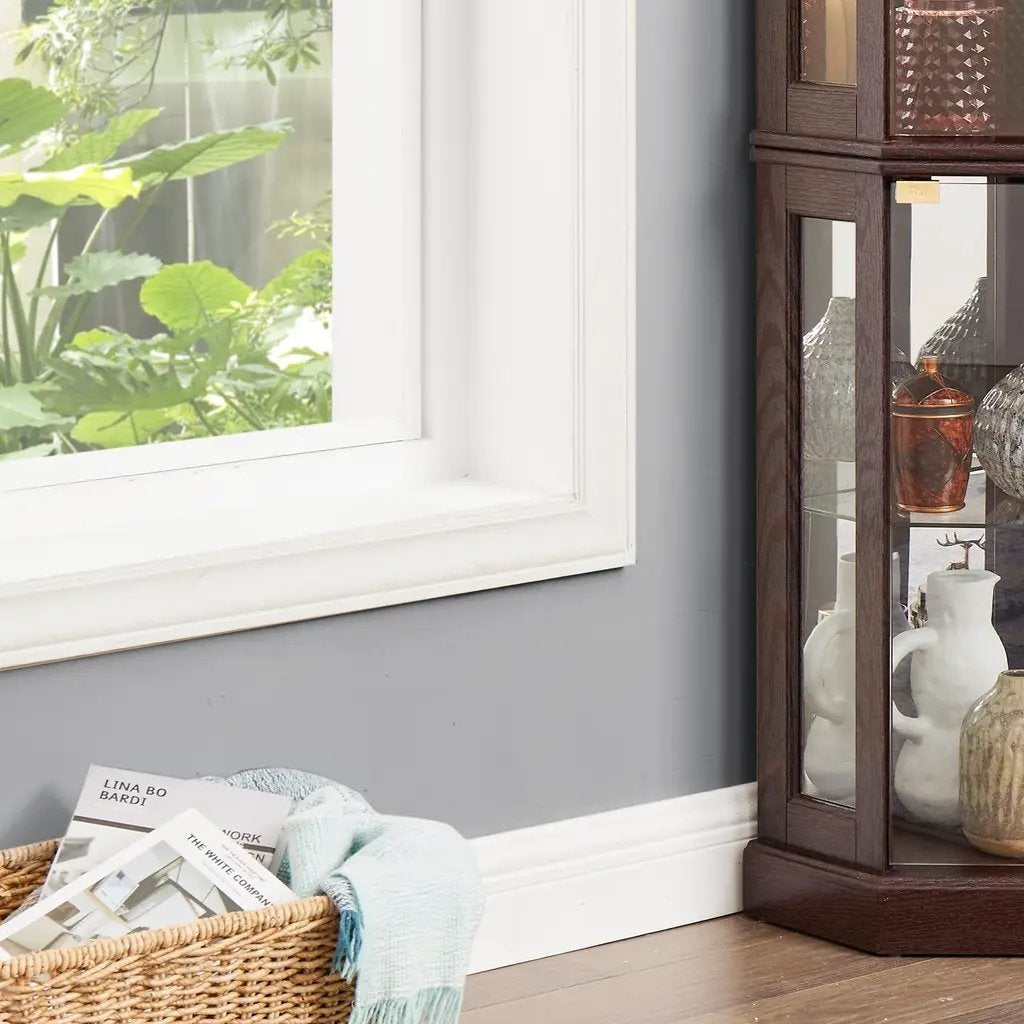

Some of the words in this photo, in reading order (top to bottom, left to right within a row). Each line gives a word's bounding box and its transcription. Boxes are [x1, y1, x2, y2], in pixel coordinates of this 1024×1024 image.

[104, 779, 140, 793] LINA
[146, 786, 167, 797] BO
[99, 790, 147, 806] BARDI
[187, 833, 207, 851] THE
[205, 849, 235, 875] WHITE
[233, 874, 273, 906] COMPAN
